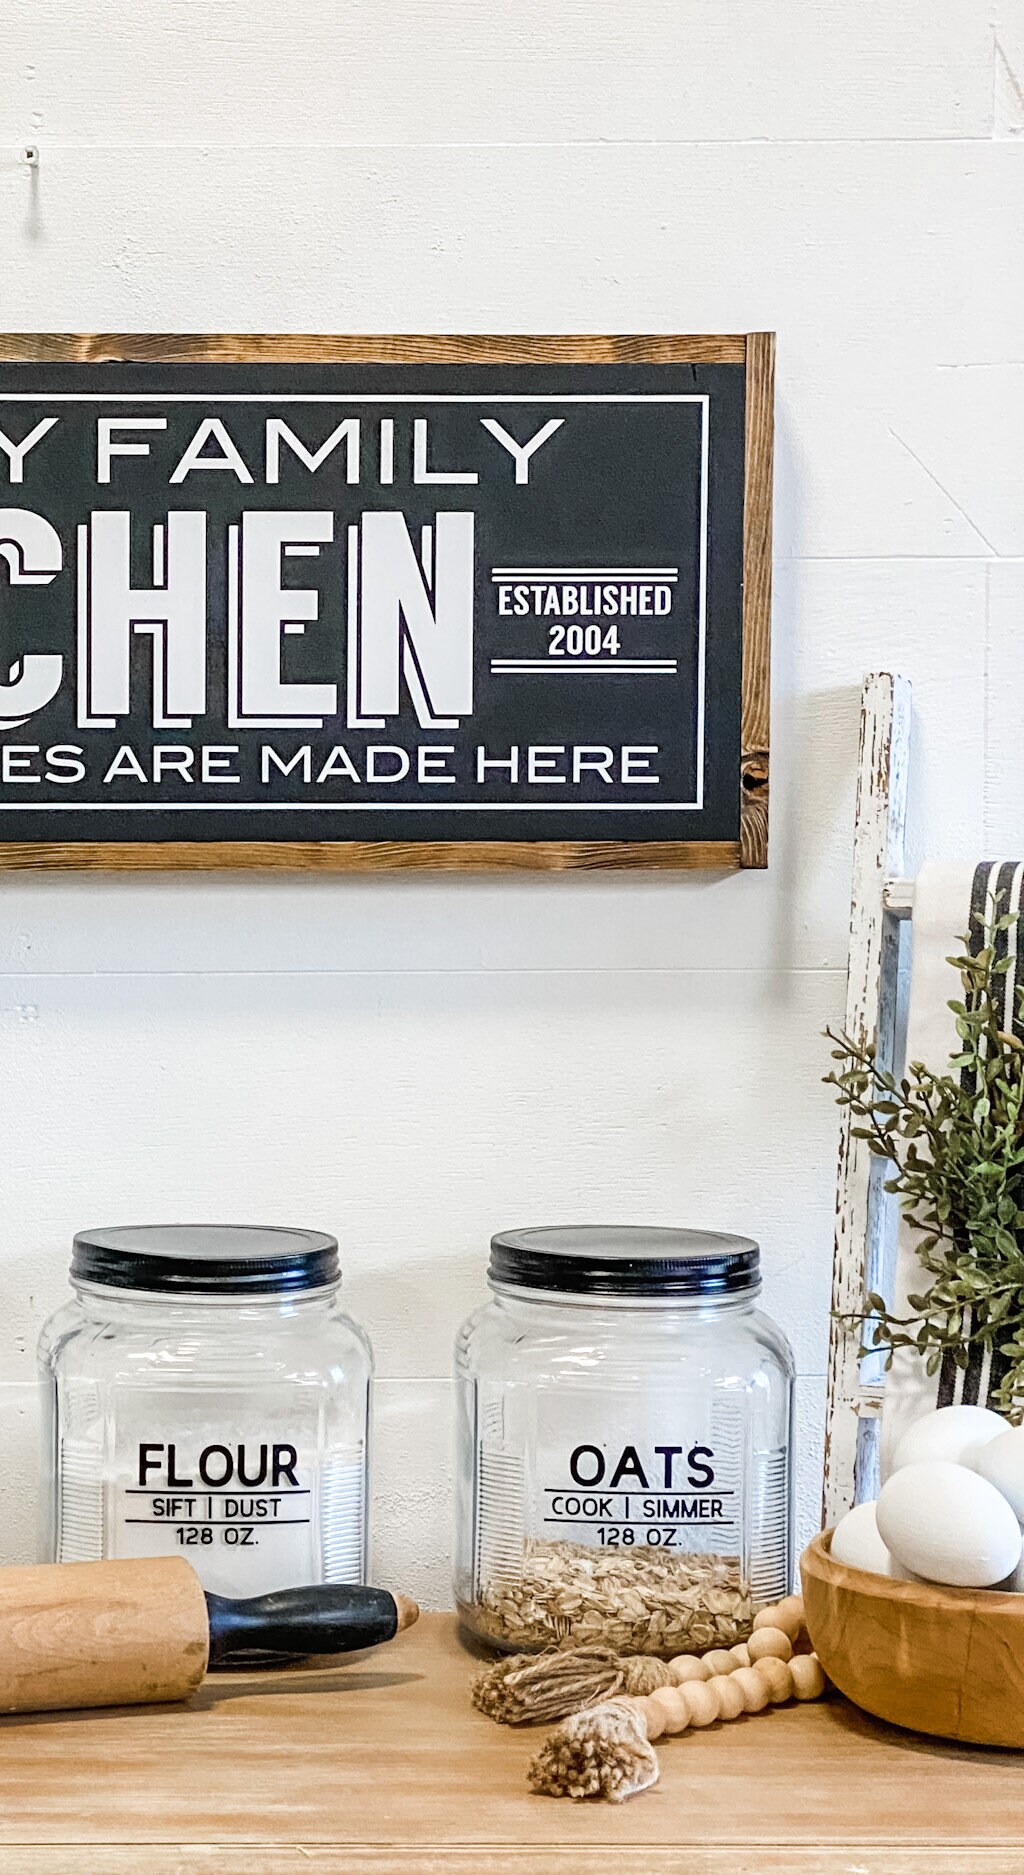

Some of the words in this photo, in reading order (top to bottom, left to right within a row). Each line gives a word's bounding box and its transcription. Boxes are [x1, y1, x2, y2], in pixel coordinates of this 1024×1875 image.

[98, 418, 565, 484] FAMILY
[499, 586, 671, 615] ESTABLISHED
[549, 625, 620, 655] 2004
[103, 746, 240, 782] ARE
[262, 746, 455, 783] MADE
[478, 746, 659, 783] HERE
[139, 1443, 300, 1487] FLOUR
[570, 1444, 715, 1489] OATS
[152, 1498, 197, 1517] SIFT
[225, 1498, 282, 1518] DUST
[551, 1497, 613, 1517] COOK
[643, 1499, 723, 1518] SIMMER
[176, 1527, 214, 1545] 128
[224, 1527, 259, 1545] OZ.
[597, 1527, 635, 1546] 128
[646, 1528, 682, 1546] OZ.
